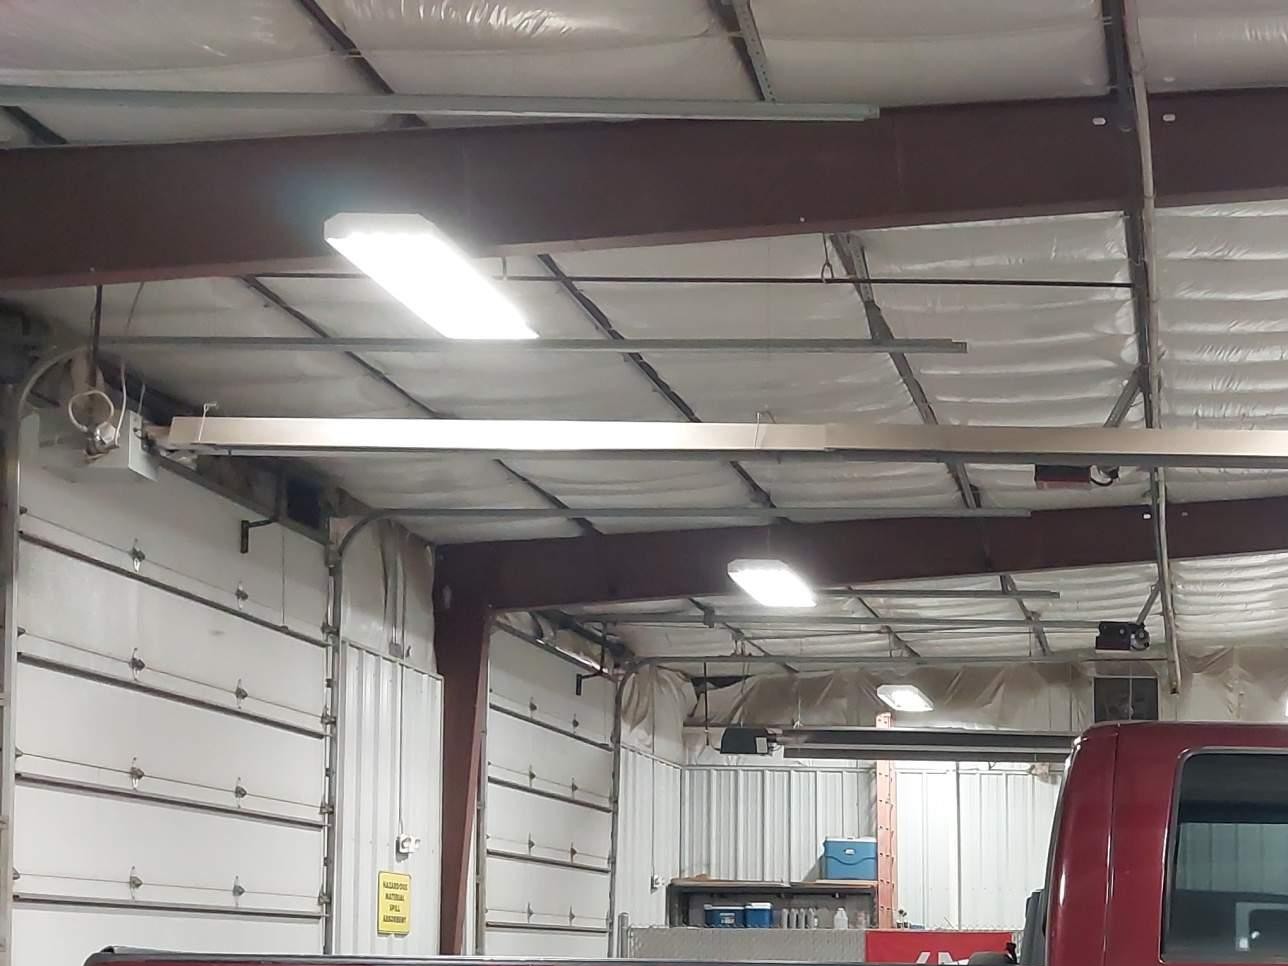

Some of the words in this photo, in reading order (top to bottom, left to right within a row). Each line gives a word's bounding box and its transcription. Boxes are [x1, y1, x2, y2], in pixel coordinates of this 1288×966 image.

[383, 881, 408, 891] HAZARDOUS
[385, 893, 404, 901] MATERIAL
[389, 904, 400, 912] SPILL
